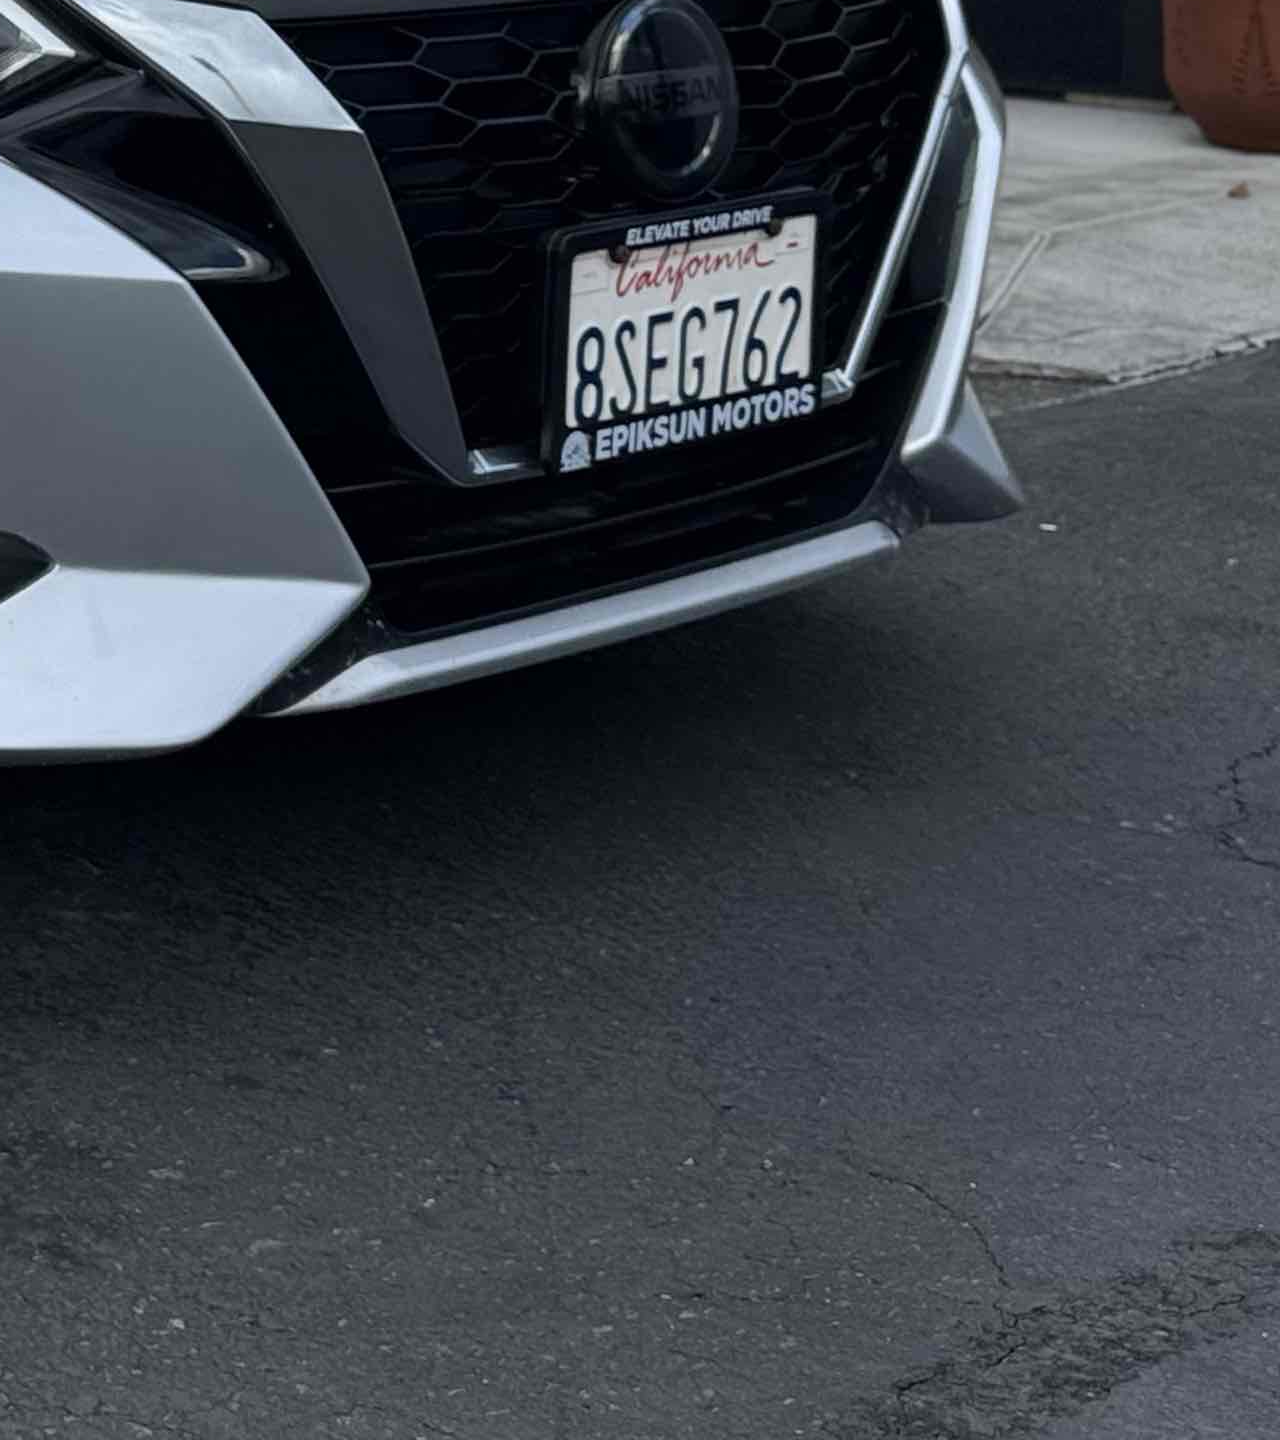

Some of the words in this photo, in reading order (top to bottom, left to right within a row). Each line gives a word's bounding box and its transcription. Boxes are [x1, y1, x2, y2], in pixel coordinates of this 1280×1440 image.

[625, 219, 689, 246] ELEVATE
[692, 212, 732, 235] YOUR
[732, 206, 774, 228] DRIVE
[614, 242, 774, 302] California
[575, 286, 803, 426] 8SEG762
[595, 407, 706, 460] EPIKSUN
[712, 383, 815, 434] MOTORS
